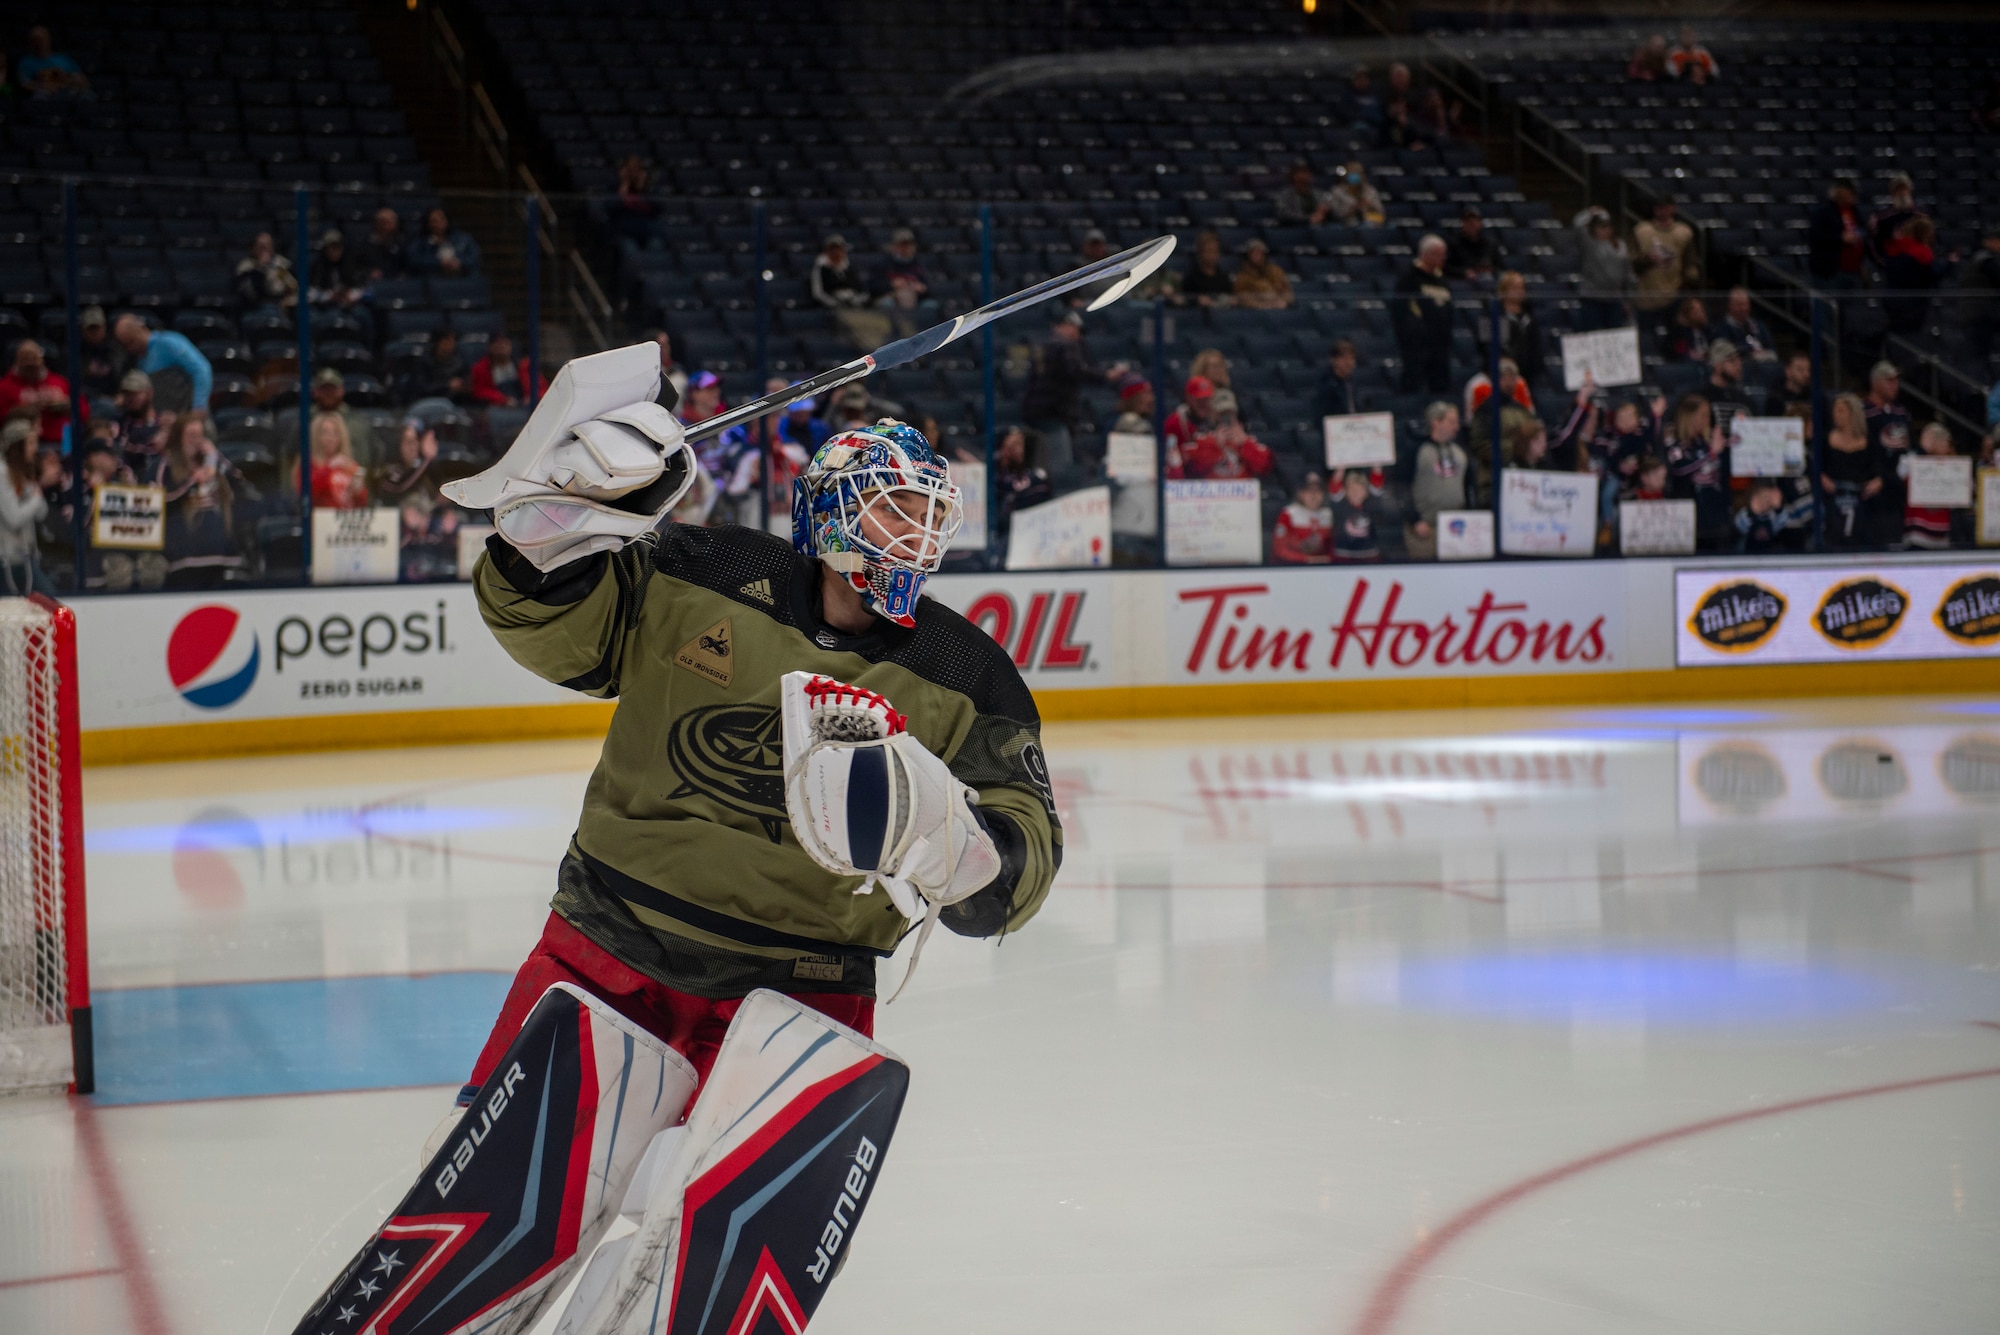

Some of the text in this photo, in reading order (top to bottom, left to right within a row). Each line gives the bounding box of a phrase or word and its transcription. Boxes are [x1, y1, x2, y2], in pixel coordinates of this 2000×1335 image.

[739, 586, 775, 606] adidas
[275, 599, 447, 674] pepsi
[717, 628, 725, 639] 1
[963, 590, 1092, 672] OIL
[1178, 577, 1607, 674] Tim Hortons
[679, 655, 729, 683] OLD IRONSIDES
[301, 676, 424, 699] ZERO SUGAR
[809, 964, 840, 979] NICK
